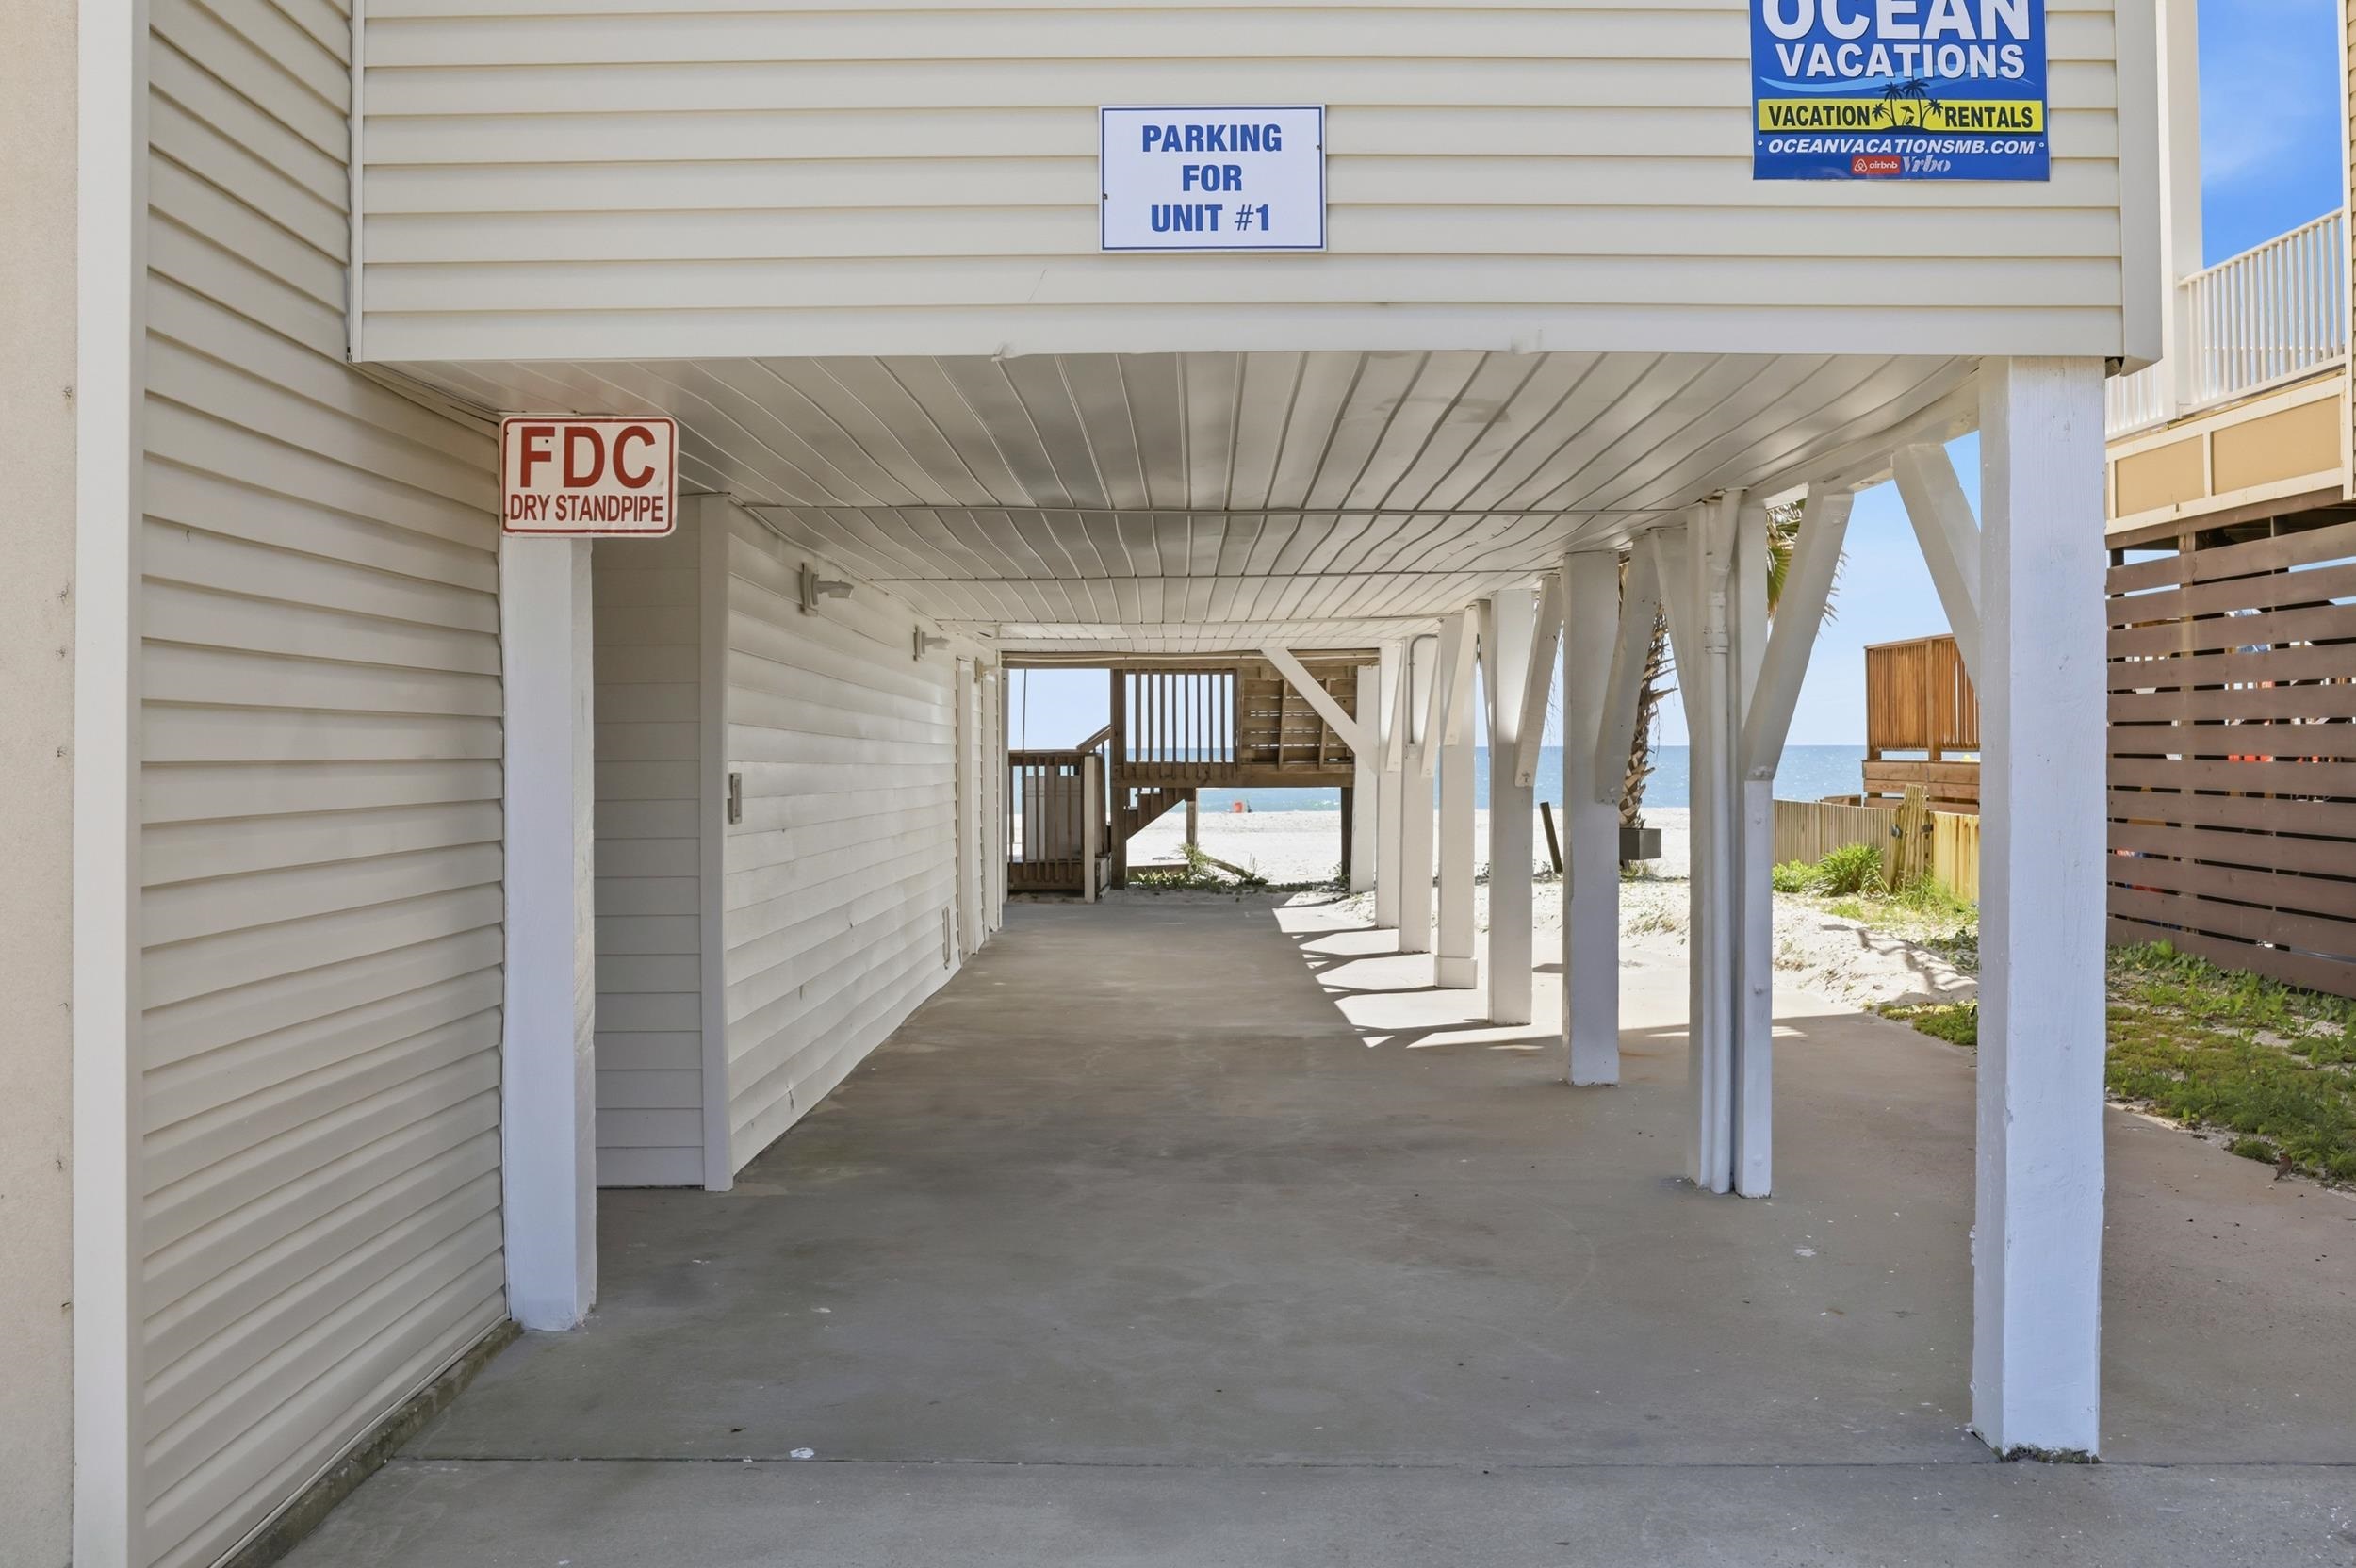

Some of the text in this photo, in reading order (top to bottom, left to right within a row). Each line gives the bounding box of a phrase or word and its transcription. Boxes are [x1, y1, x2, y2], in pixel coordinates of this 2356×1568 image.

[1762, 0, 2030, 40] OCEAN
[1775, 43, 2025, 79] VACATIONS
[1768, 105, 2033, 128] VACATION RENTALS
[1142, 123, 1282, 153] PARKING
[1768, 139, 2035, 155] OCEANVACATIONSMB.COM
[1182, 164, 1242, 191] FOR
[1903, 155, 1951, 172] Vrbo
[1151, 204, 1269, 232] UNIT #1
[520, 425, 656, 489] FDC
[510, 494, 663, 522] DRY STANDPIPE
